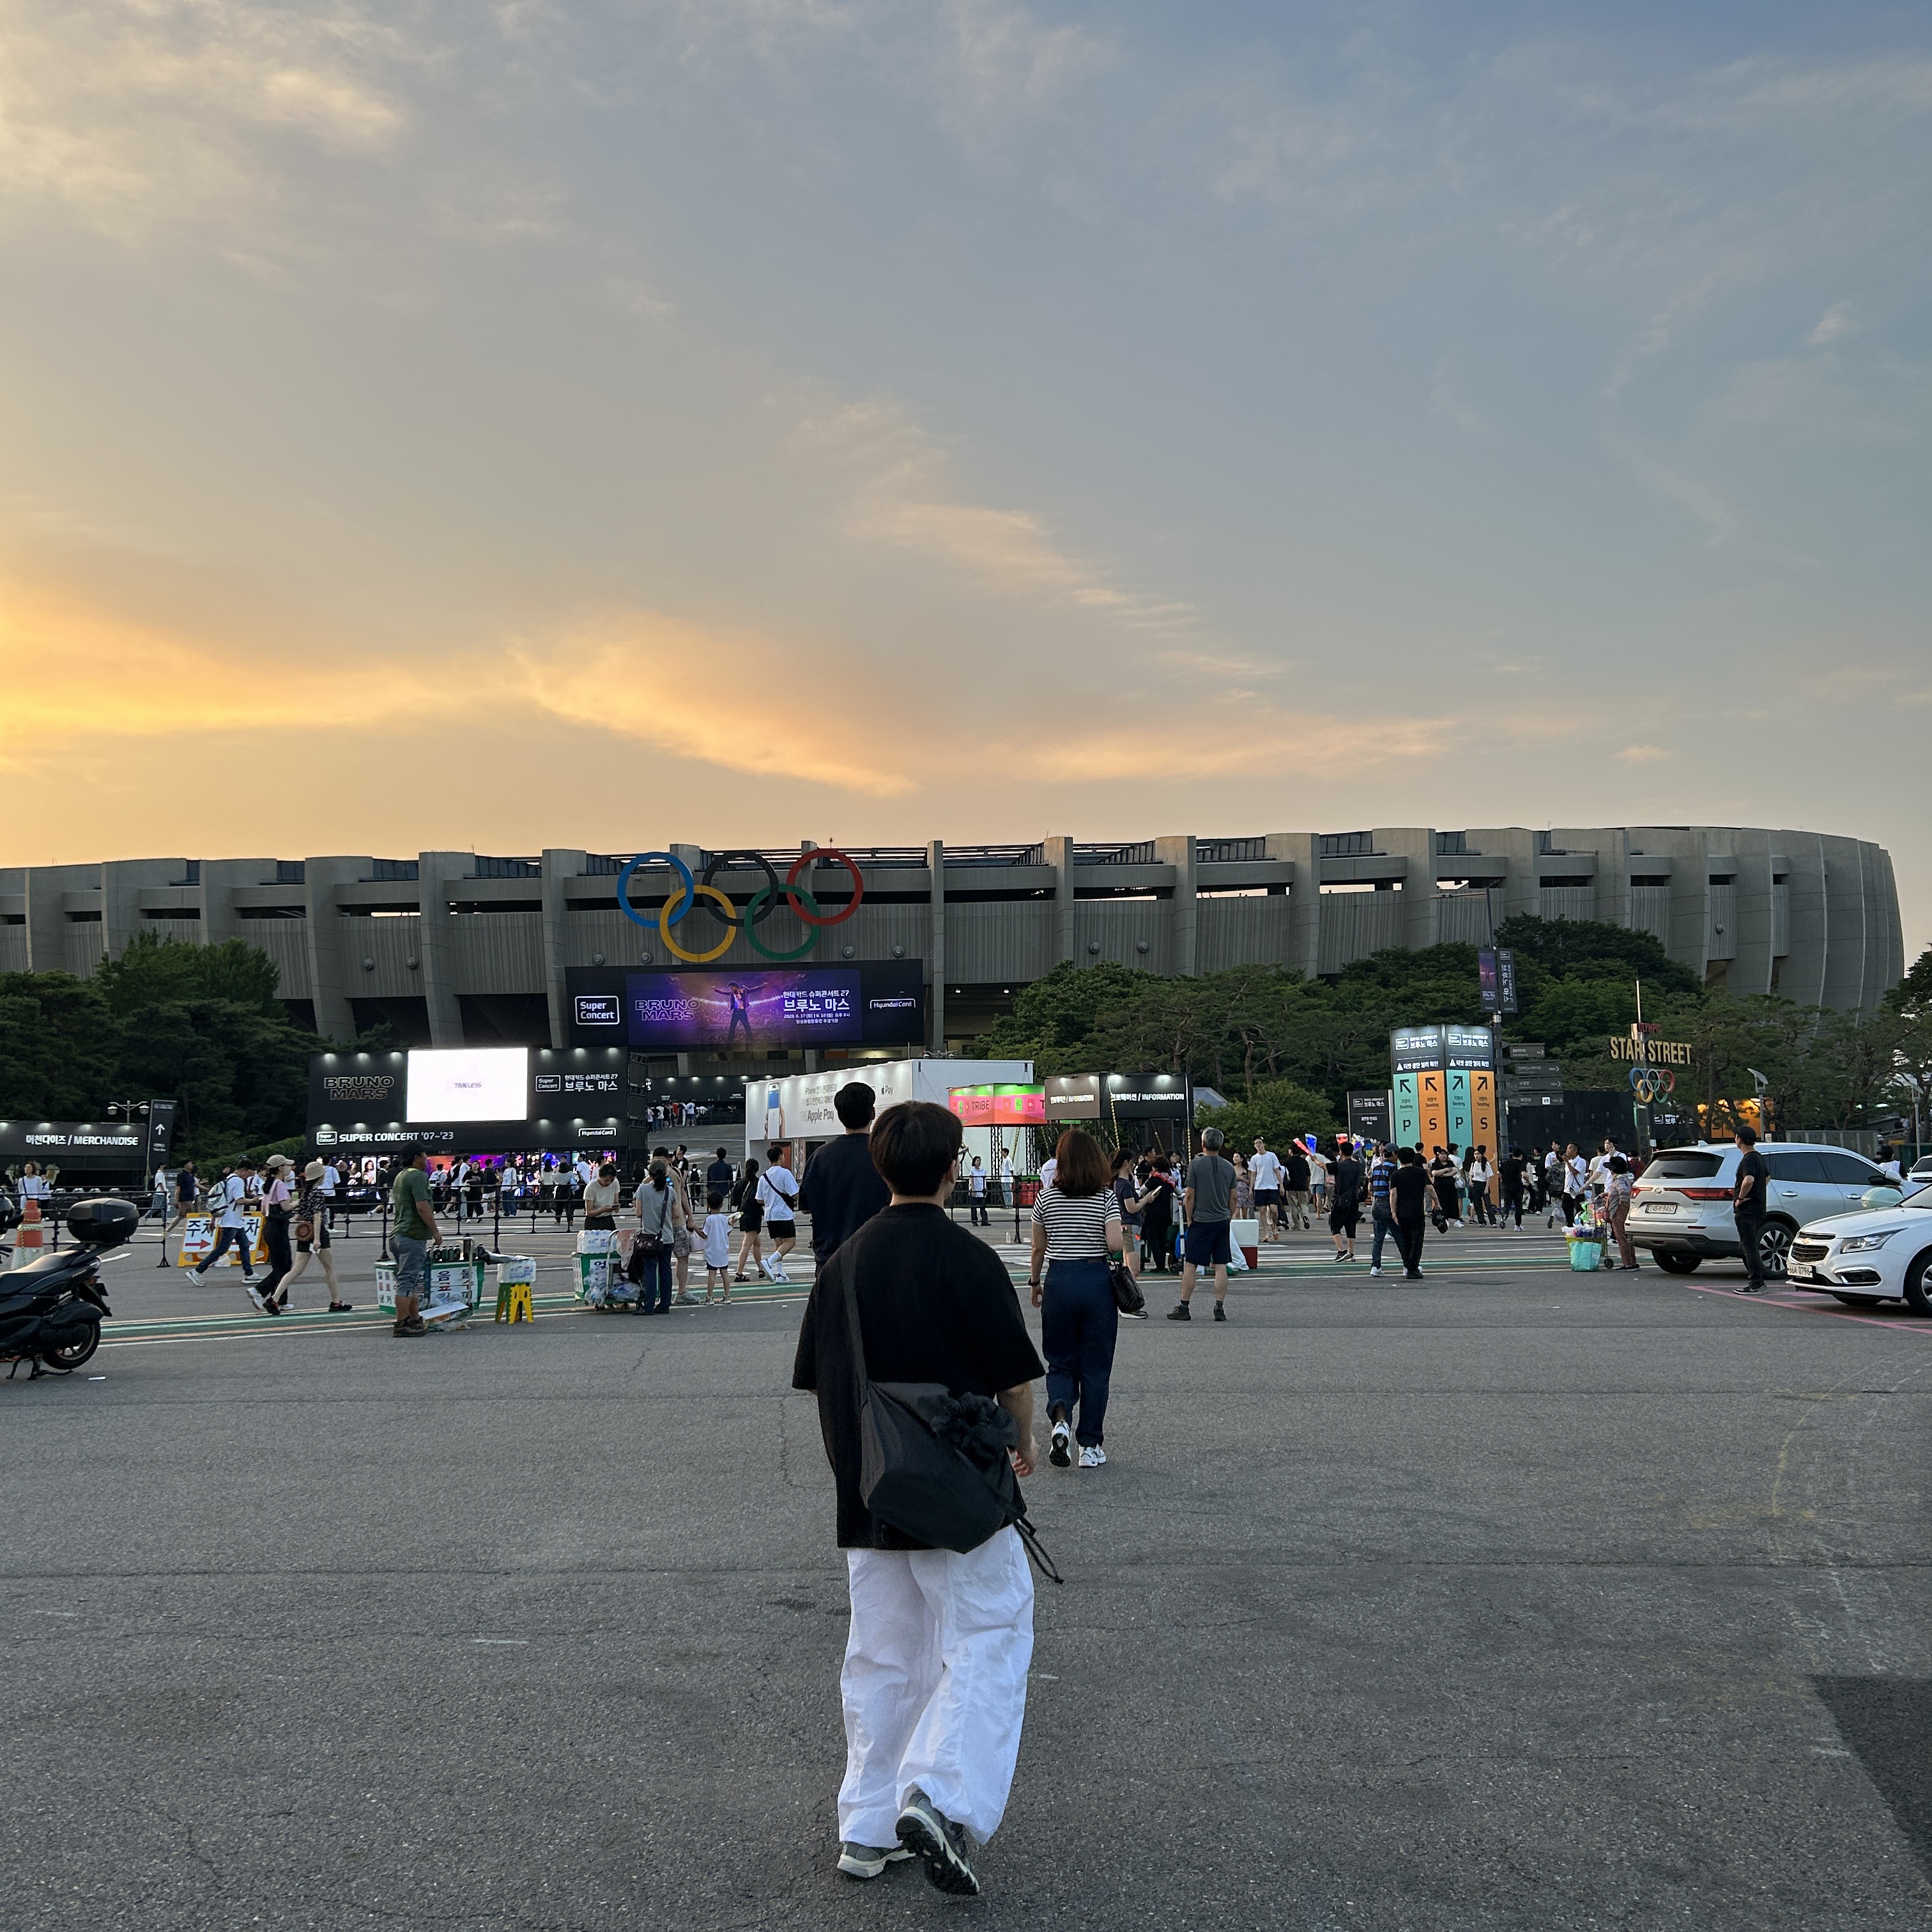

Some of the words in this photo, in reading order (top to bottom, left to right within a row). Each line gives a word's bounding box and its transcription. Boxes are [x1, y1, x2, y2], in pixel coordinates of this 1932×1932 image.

[1503, 988, 1509, 1002] 마스
[580, 1002, 607, 1011] Super
[634, 999, 700, 1011] BRUNO
[784, 999, 822, 1012] 브루노
[825, 998, 850, 1011] 마스
[641, 1010, 695, 1021] MARS
[1638, 1023, 1661, 1032] OLYMPIC
[1610, 1036, 1644, 1061] STAR
[1648, 1040, 1692, 1064] STREET
[324, 1076, 394, 1089] BRUNO
[564, 1081, 595, 1092] 브루노
[598, 1080, 618, 1091] 마스
[330, 1088, 388, 1100] MARS
[885, 1085, 893, 1096] Pay
[971, 1100, 990, 1110] TRIBE
[808, 1108, 822, 1124] Apple
[824, 1108, 834, 1123] Pay
[1403, 1119, 1411, 1131] P
[1429, 1117, 1437, 1130] S
[1455, 1116, 1464, 1129] P
[1480, 1117, 1488, 1130] S
[26, 1135, 66, 1146] 머천다이즈
[67, 1134, 73, 1146] /
[73, 1135, 139, 1146] MERCHANDISE
[339, 1133, 372, 1142] SUPER
[374, 1132, 419, 1142] CONCERT
[243, 1218, 260, 1236] 차
